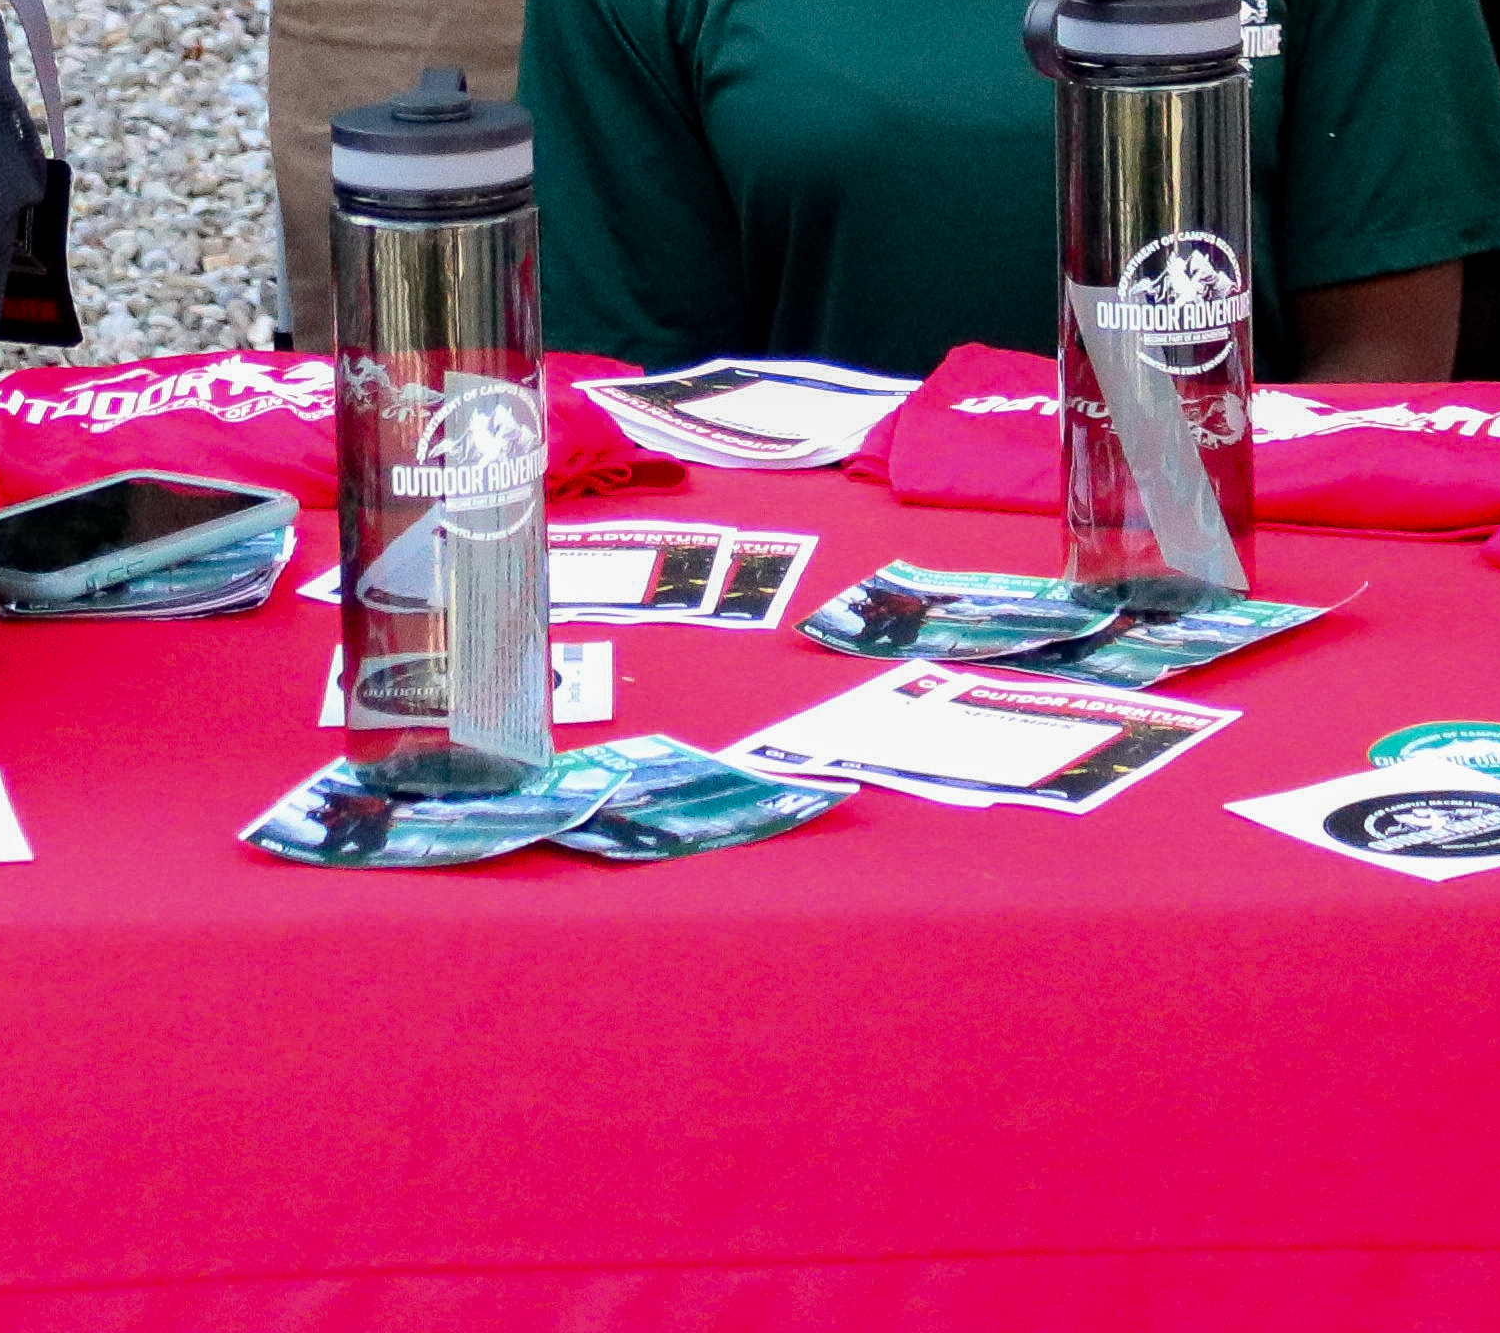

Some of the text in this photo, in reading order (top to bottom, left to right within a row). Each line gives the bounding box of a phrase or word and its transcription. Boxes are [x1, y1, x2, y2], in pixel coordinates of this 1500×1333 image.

[1177, 231, 1217, 244] CAMPUS
[1096, 301, 1181, 332] OUTDOOR
[392, 465, 484, 497] OUTDOOR
[1071, 698, 1217, 728] ADVENTURE
